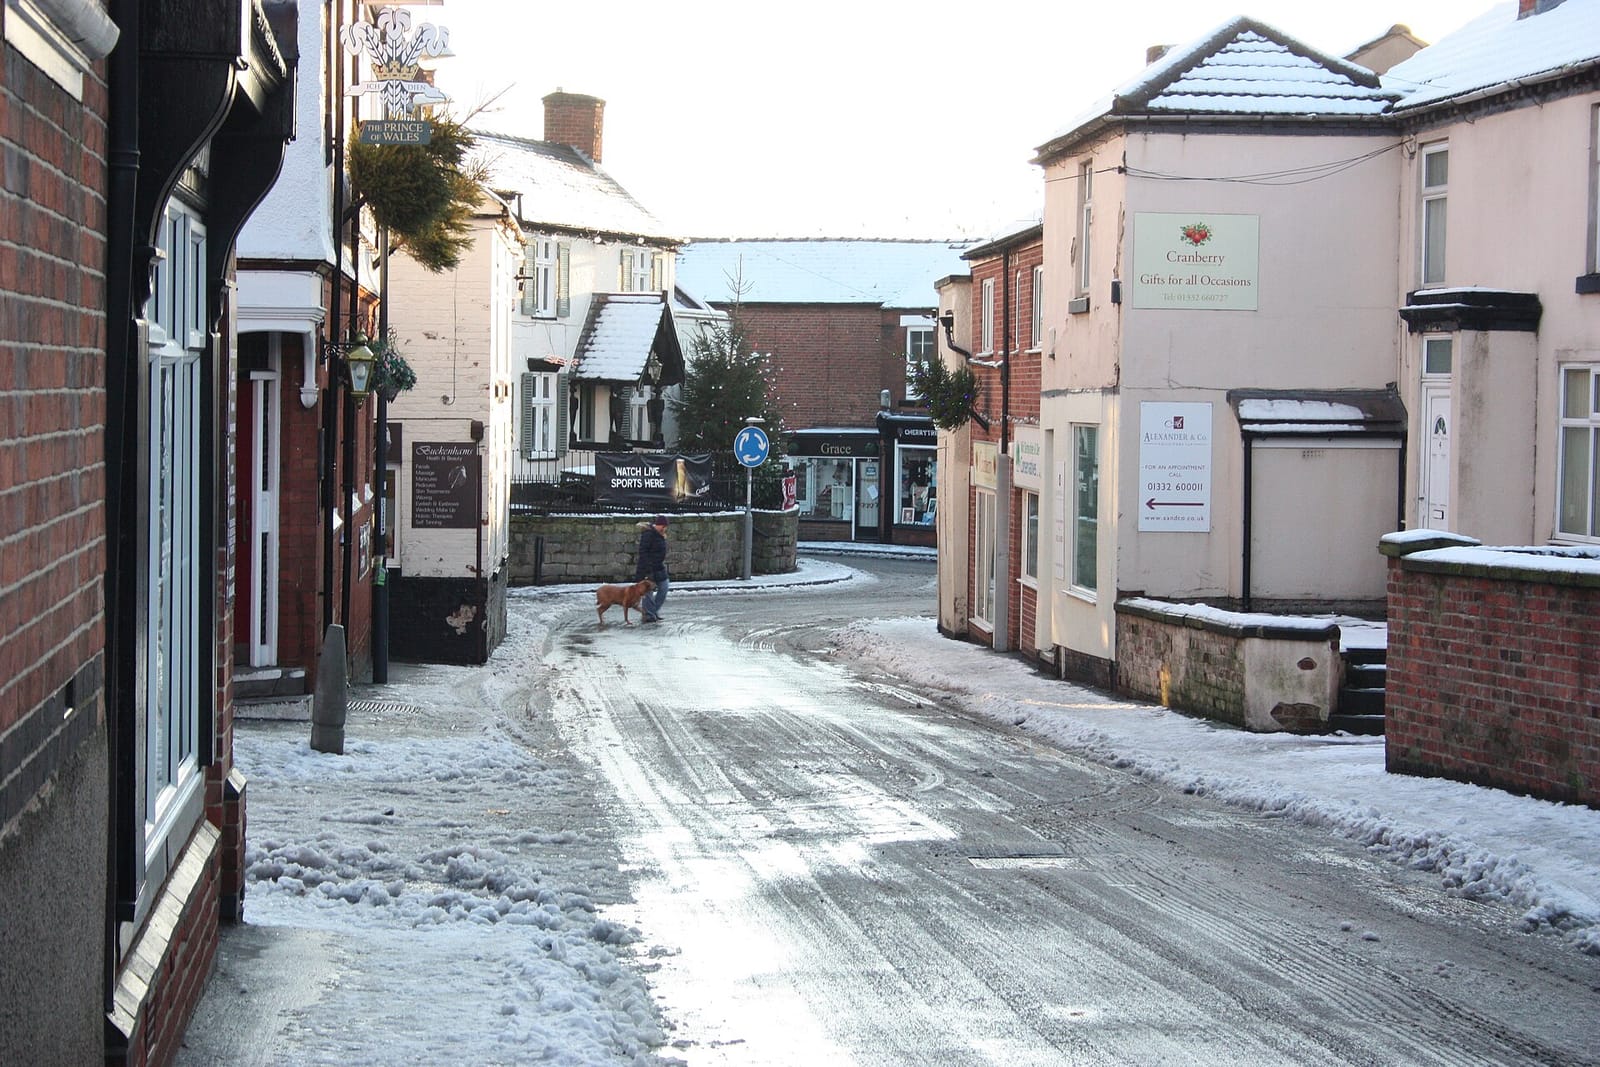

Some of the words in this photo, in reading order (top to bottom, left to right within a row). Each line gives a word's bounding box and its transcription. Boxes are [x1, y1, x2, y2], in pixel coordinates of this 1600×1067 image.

[407, 83, 426, 91] DIEN
[383, 122, 424, 133] PRINCE
[382, 132, 420, 142] WALES
[1166, 250, 1225, 266] Cranberry
[1140, 273, 1166, 285] Gifts
[1167, 274, 1183, 286] for
[1185, 274, 1198, 286] all
[1200, 275, 1251, 287] Occasions
[1189, 433, 1196, 441] &
[415, 445, 474, 456] Buckenhams
[820, 442, 852, 455] Grace
[615, 466, 642, 477] WATCH
[643, 466, 661, 476] LIVE
[610, 478, 643, 488] SPORTS
[644, 478, 665, 488] HERE
[1147, 482, 1172, 491] 01332
[1175, 483, 1203, 491] 600011
